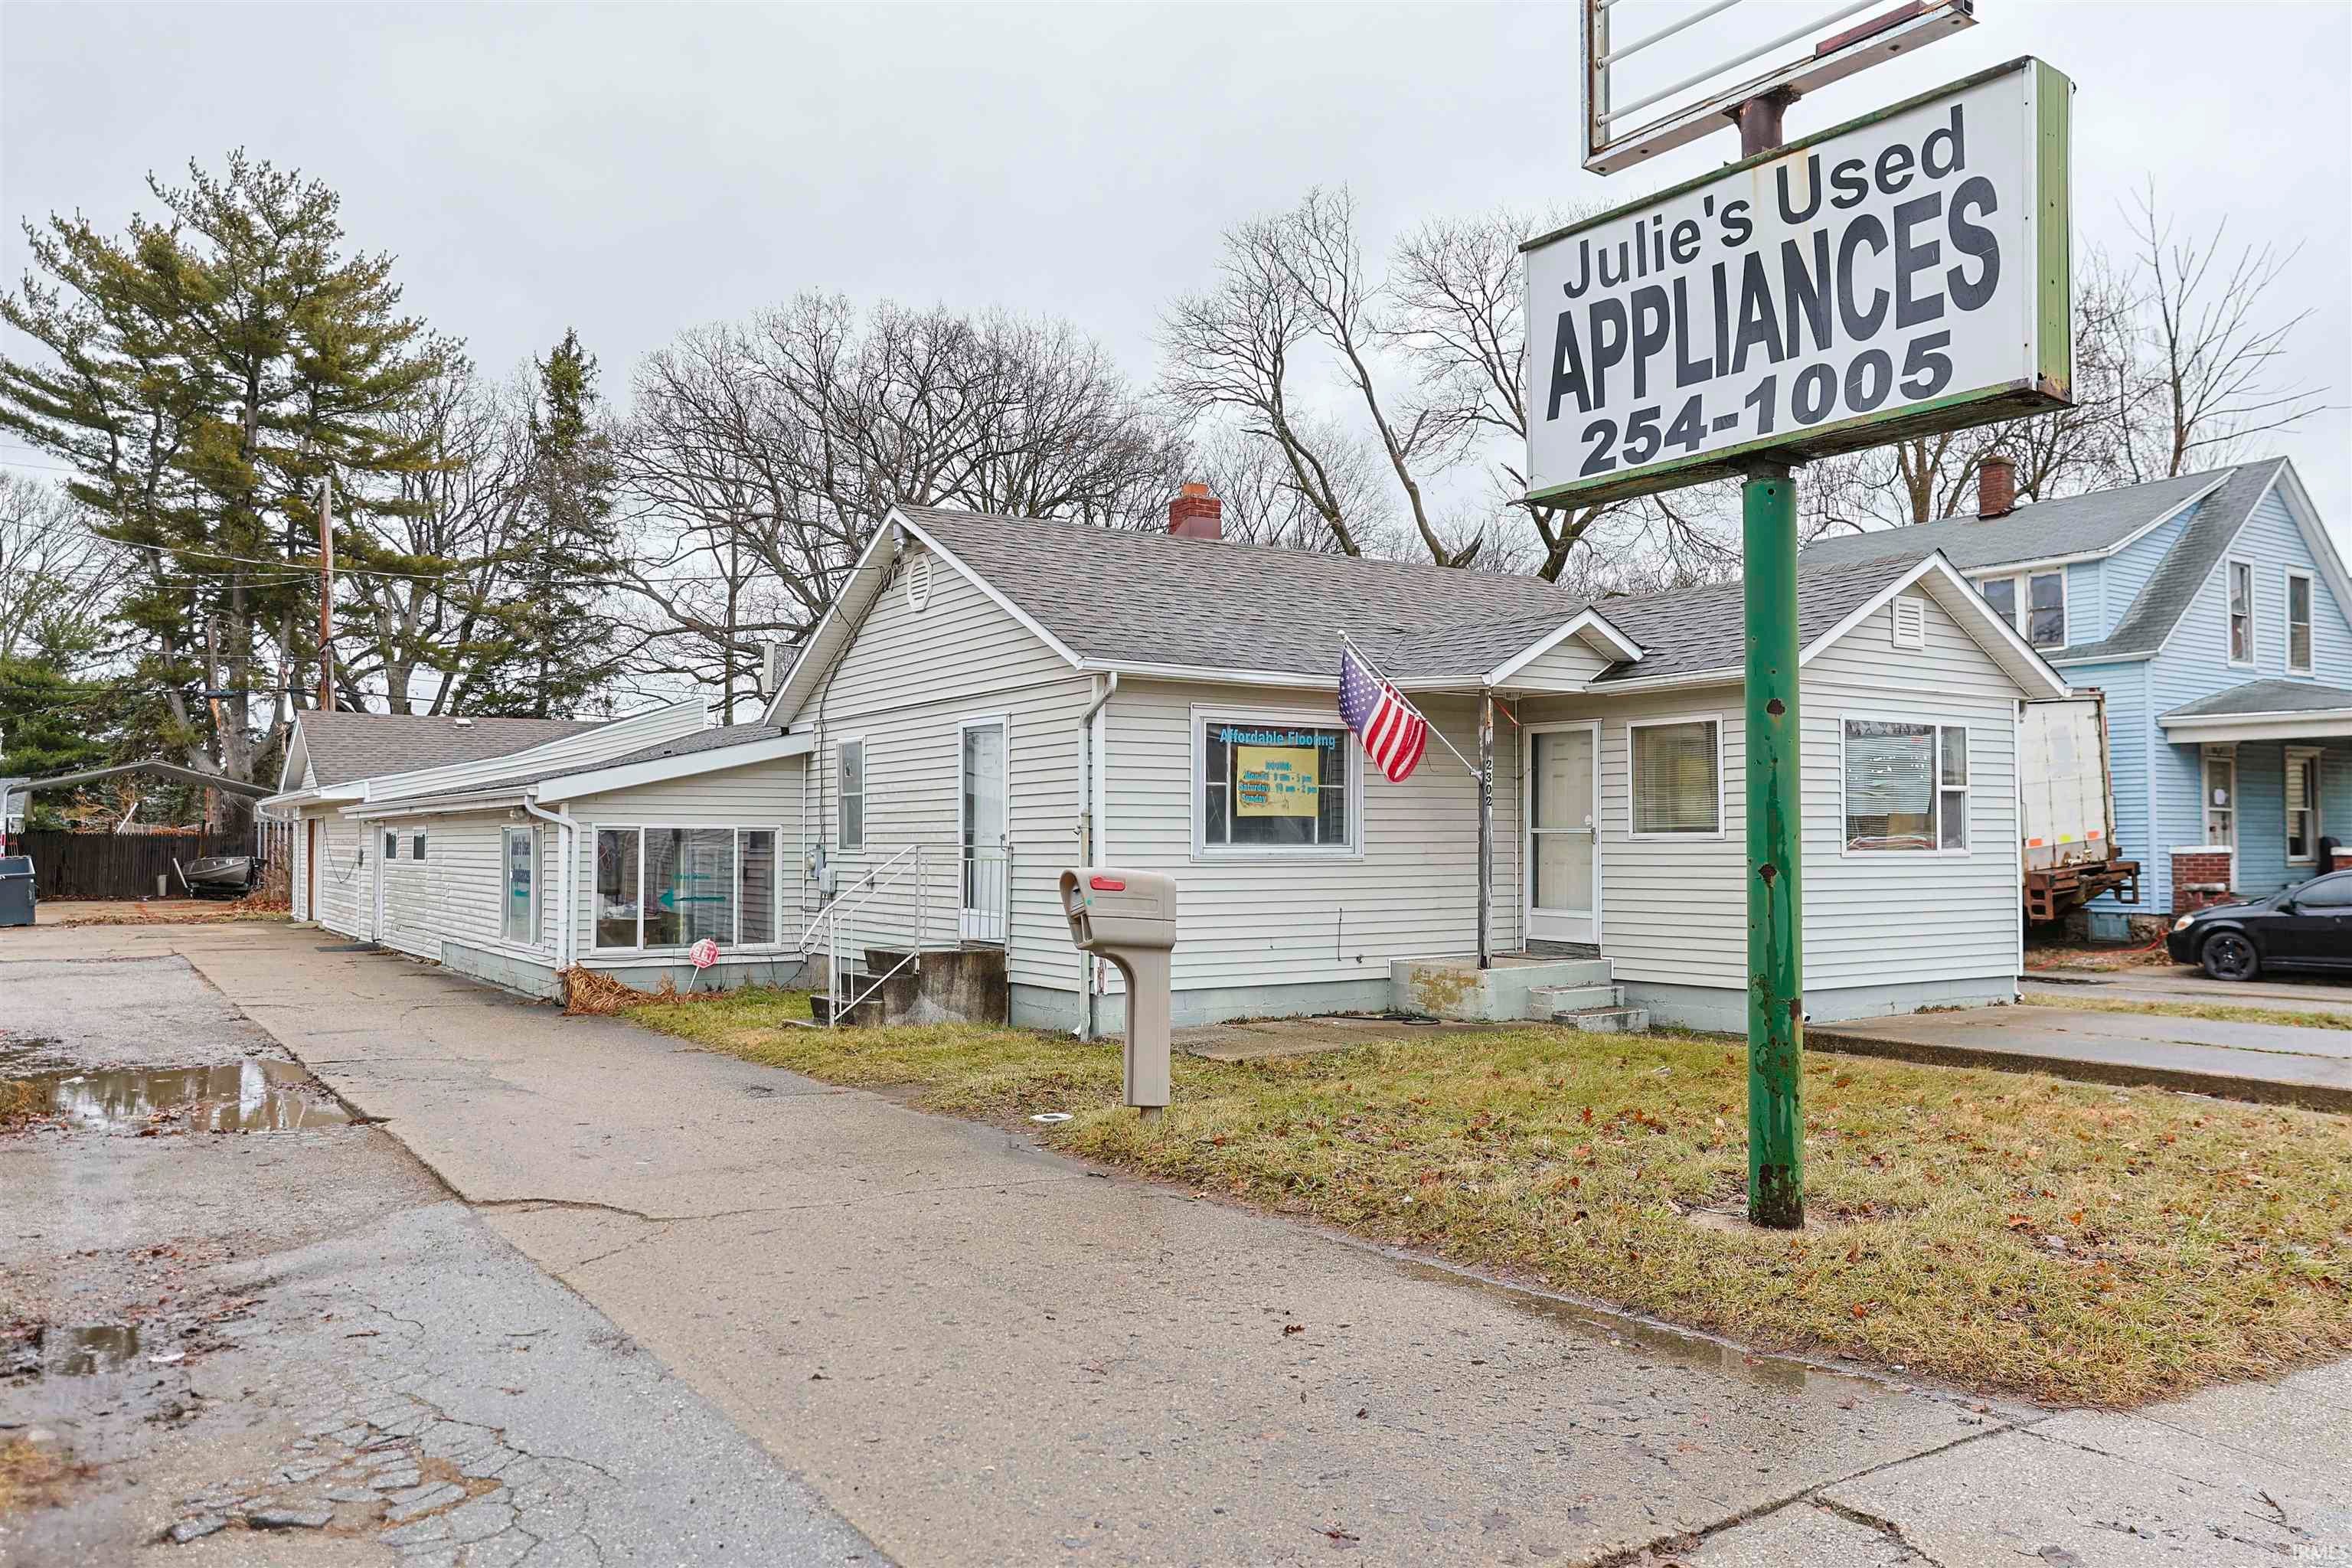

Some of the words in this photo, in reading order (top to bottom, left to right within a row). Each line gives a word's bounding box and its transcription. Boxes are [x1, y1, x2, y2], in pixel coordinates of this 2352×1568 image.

[1563, 194, 1753, 299] Julie's
[1775, 103, 1966, 225] Used
[1546, 176, 2001, 422] APPLIANCES
[1579, 329, 1954, 478] 254-1005
[1220, 728, 1284, 744] Affordable
[1288, 732, 1335, 750] Flooring
[1238, 782, 1269, 792] Saturday
[1242, 793, 1266, 803] Sunday
